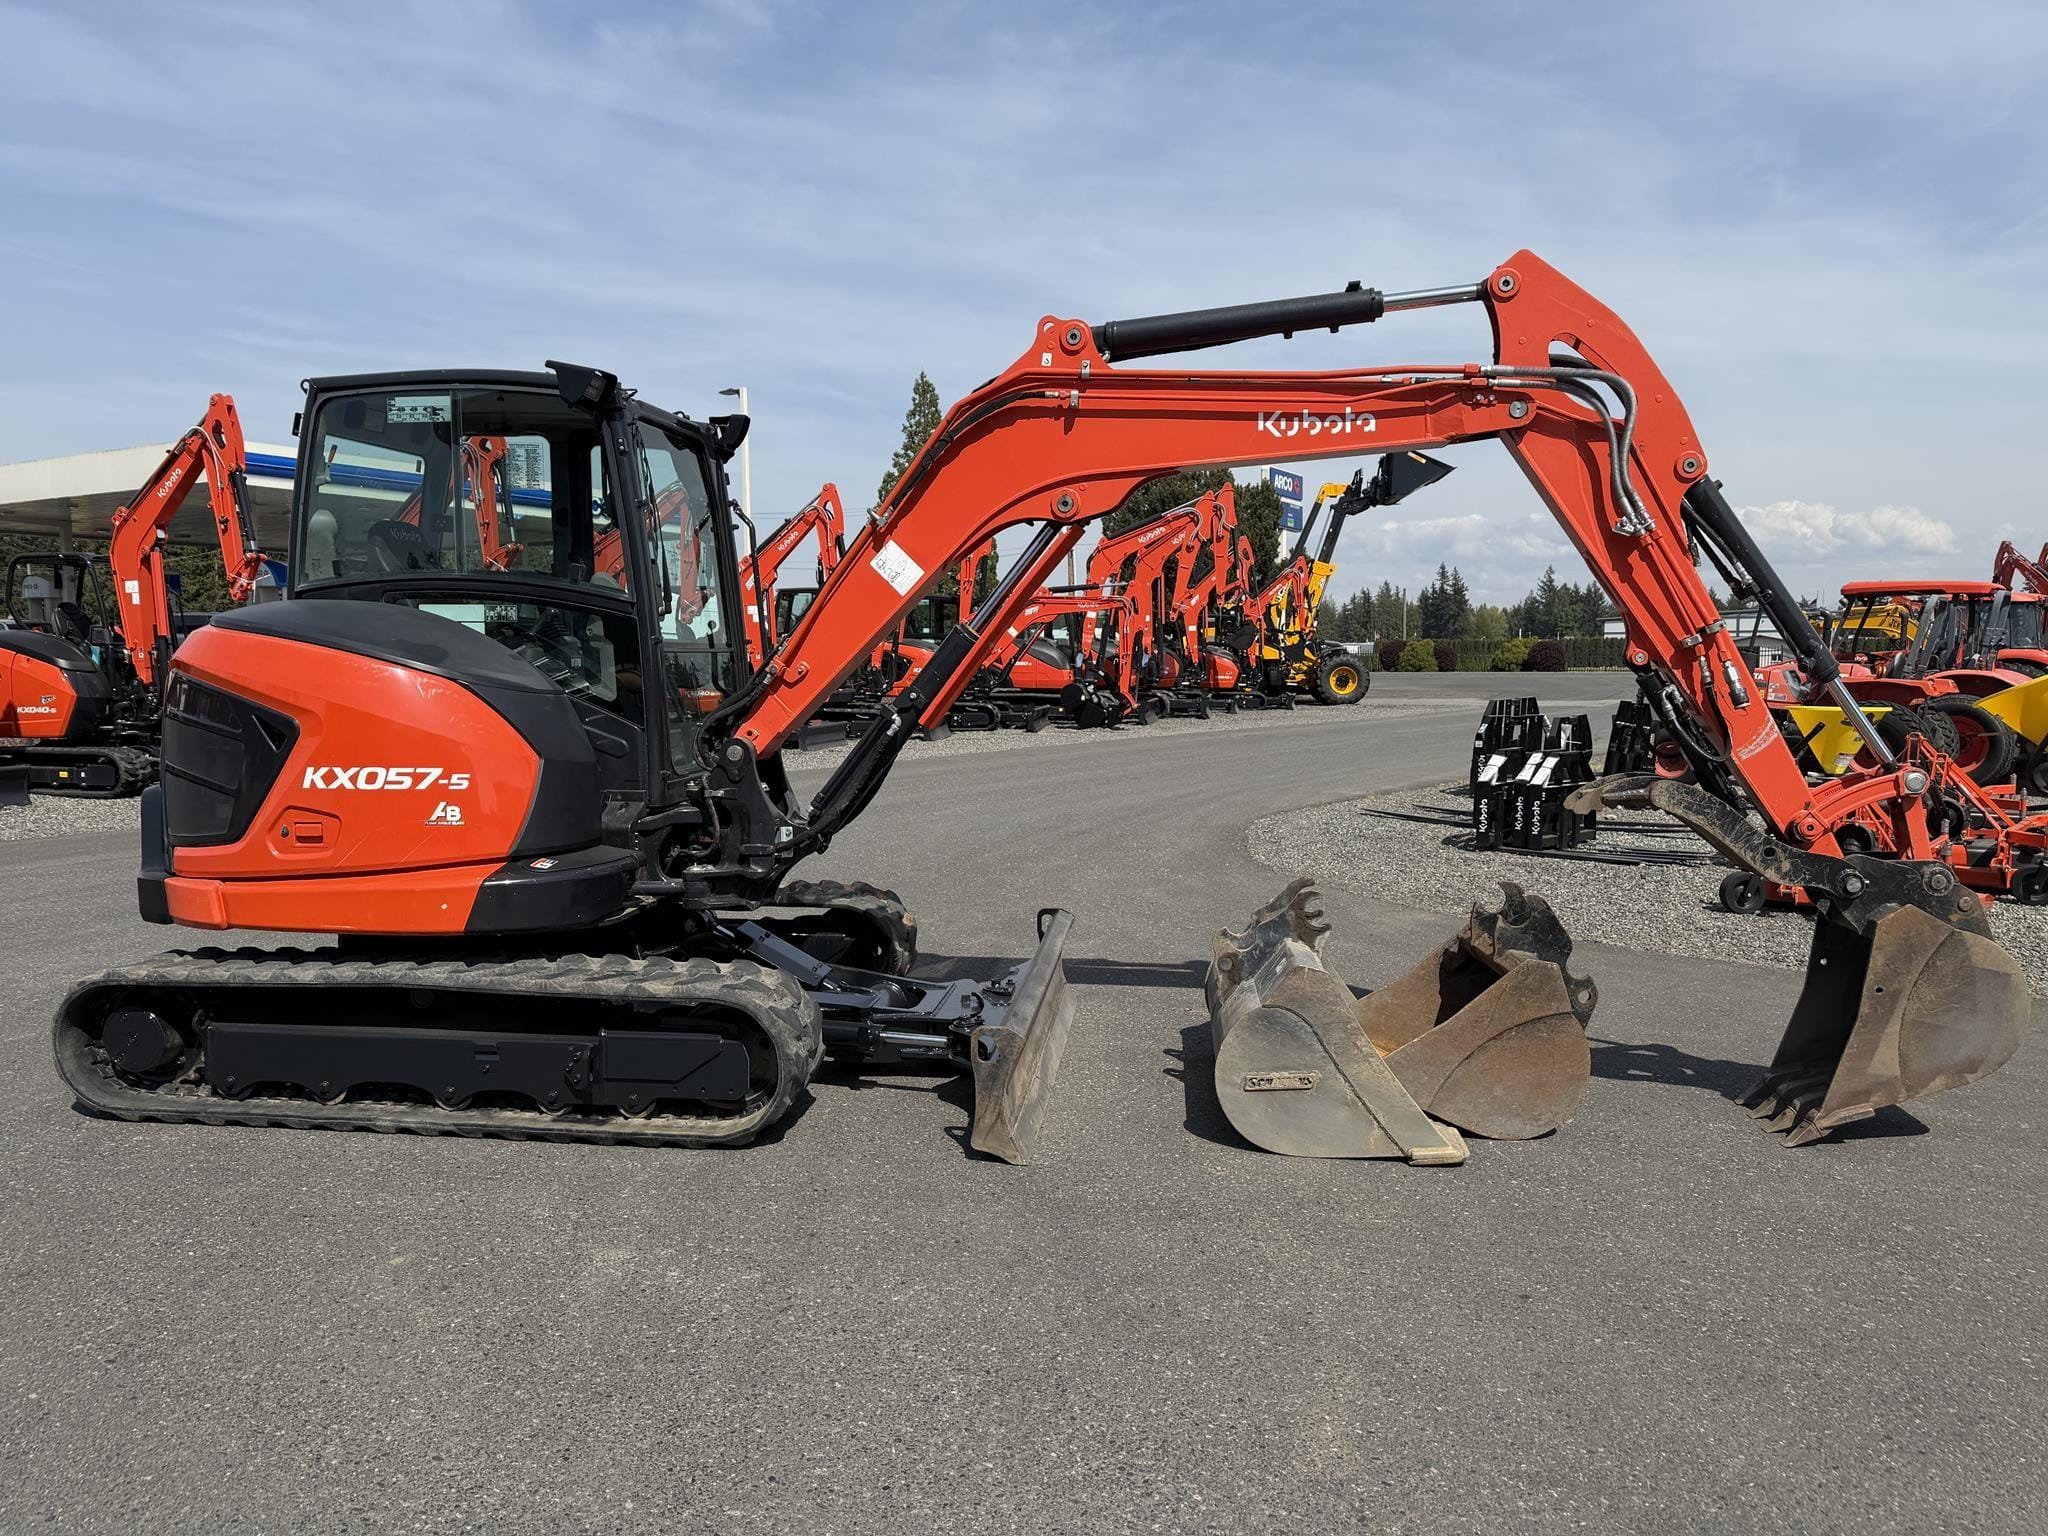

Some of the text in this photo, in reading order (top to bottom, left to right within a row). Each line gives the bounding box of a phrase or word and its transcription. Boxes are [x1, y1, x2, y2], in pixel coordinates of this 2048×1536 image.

[1258, 406, 1376, 437] Kubota
[157, 468, 182, 498] Kubota
[1275, 474, 1293, 491] ARCO
[777, 531, 799, 551] Kubota
[1138, 526, 1166, 544] Kubota
[1171, 531, 1186, 545] Kub
[302, 766, 470, 790] KX057-5
[430, 802, 462, 821] AB
[1479, 798, 1488, 833] Kubota
[1515, 796, 1524, 830] Kubota
[1531, 800, 1541, 834] Kubota
